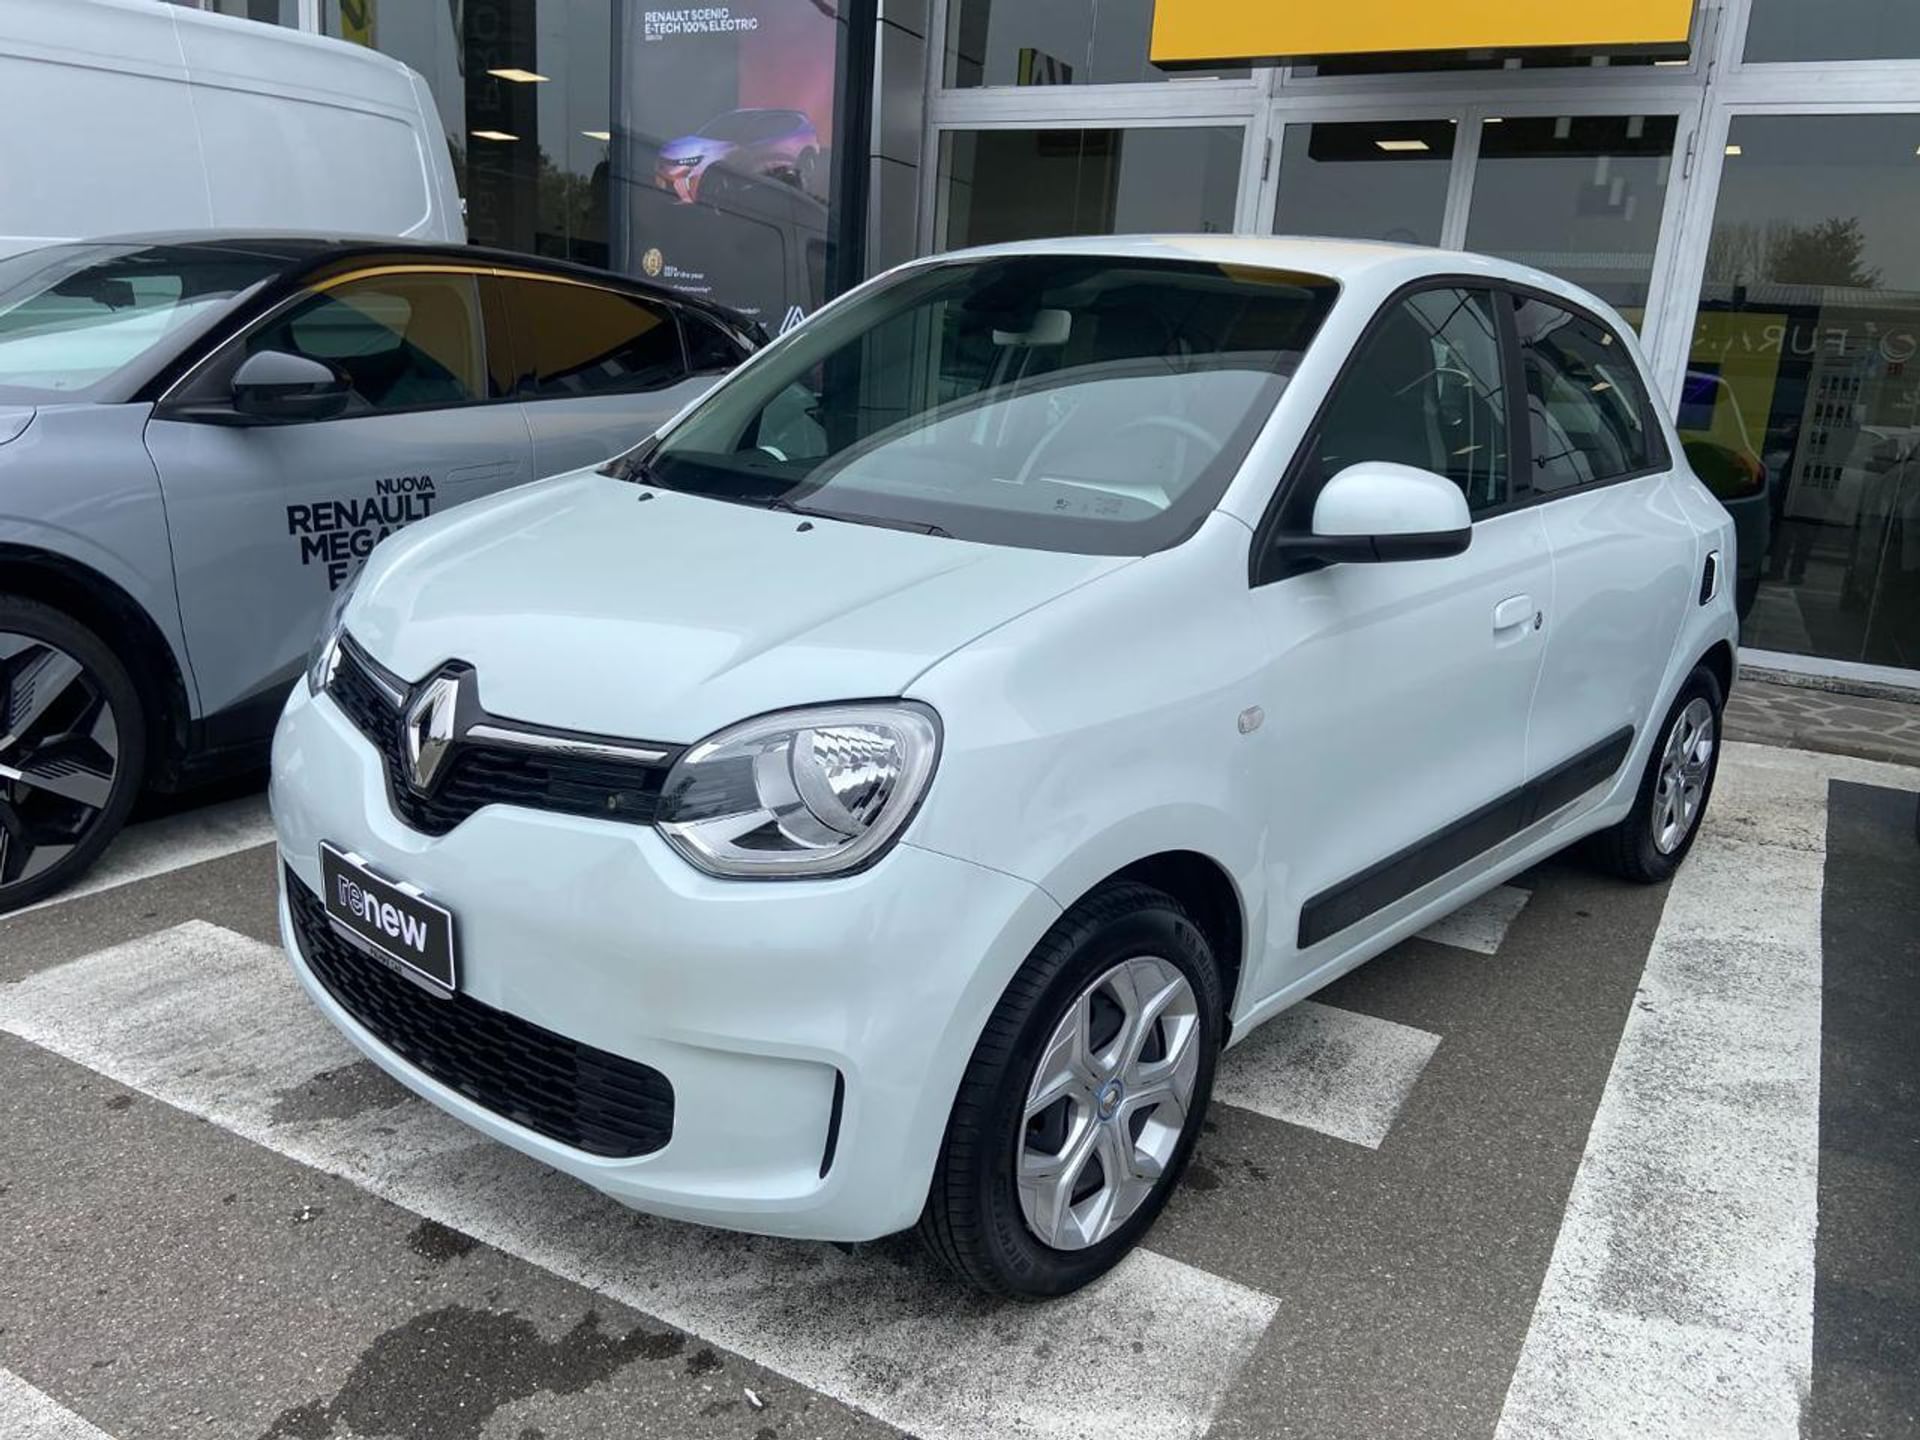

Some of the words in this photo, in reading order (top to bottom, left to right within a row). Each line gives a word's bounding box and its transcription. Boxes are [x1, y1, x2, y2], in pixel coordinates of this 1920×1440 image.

[644, 11, 690, 23] RENAULT
[691, 8, 729, 20] SCENIC
[645, 22, 681, 34] E-TECH
[682, 21, 708, 33] 100%
[709, 17, 758, 32] ELECTRIC
[376, 475, 435, 495] NUOVA
[286, 492, 436, 535] RENAULT
[337, 874, 427, 953] renew
